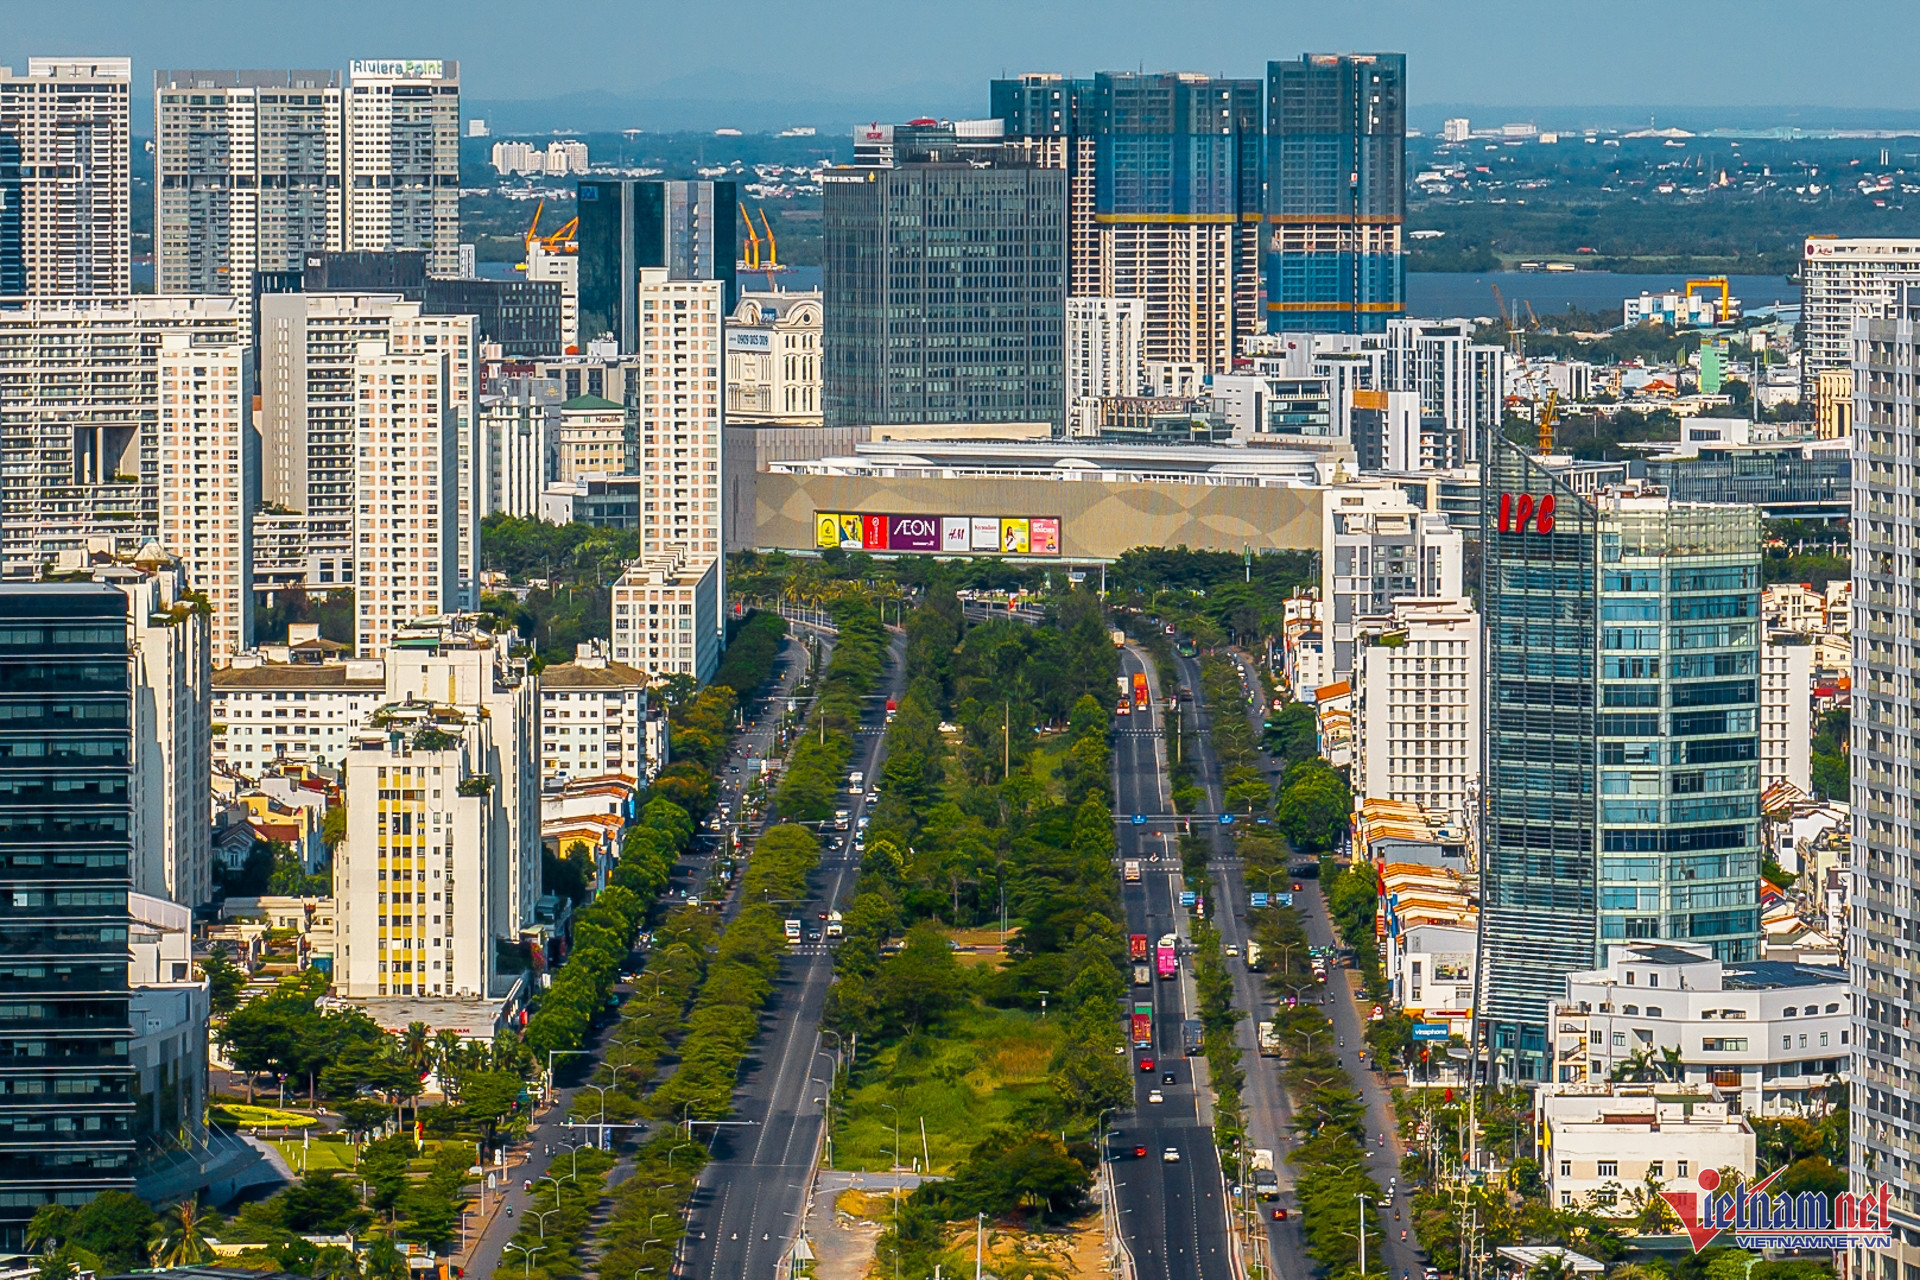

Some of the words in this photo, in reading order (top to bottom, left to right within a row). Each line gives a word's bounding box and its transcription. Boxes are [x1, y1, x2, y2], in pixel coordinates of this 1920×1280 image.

[354, 61, 403, 74] Riviera
[405, 60, 442, 74] Point
[1498, 493, 1554, 534] IPC
